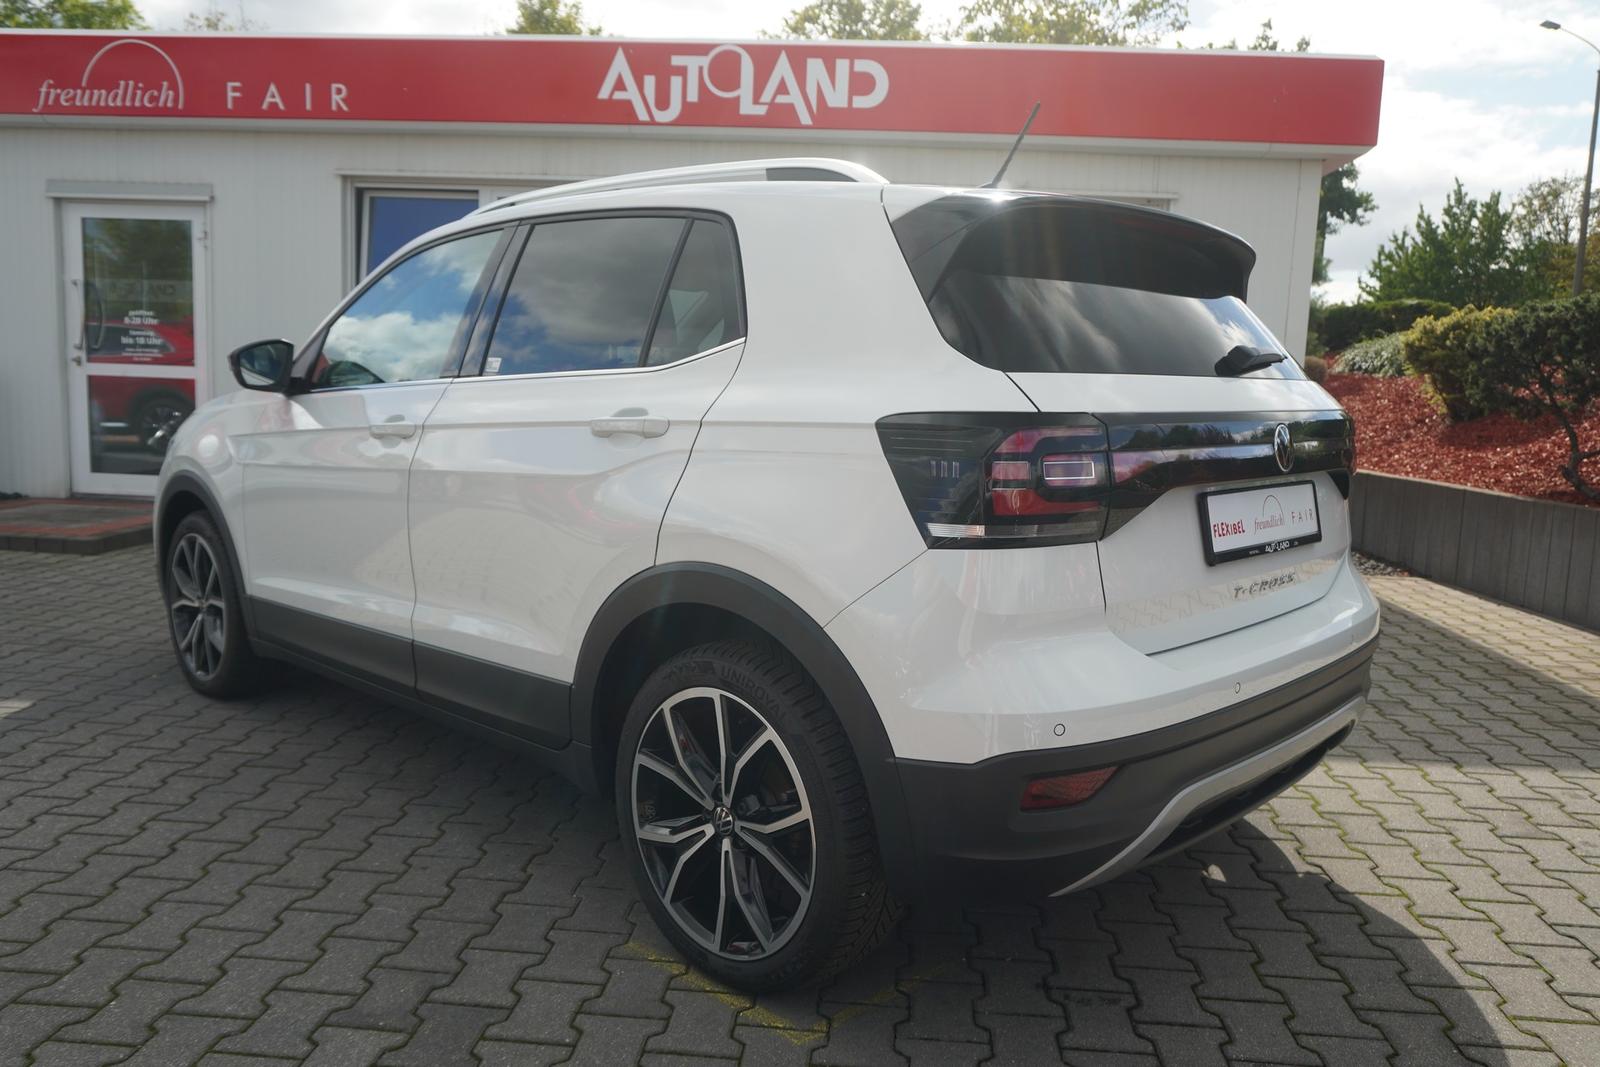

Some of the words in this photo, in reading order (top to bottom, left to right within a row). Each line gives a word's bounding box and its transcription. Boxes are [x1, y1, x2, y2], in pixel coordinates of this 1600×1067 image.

[32, 79, 176, 113] freundlich
[225, 81, 350, 112] FAIR
[597, 43, 890, 126] AUTOLAND
[1290, 508, 1315, 525] FAIR
